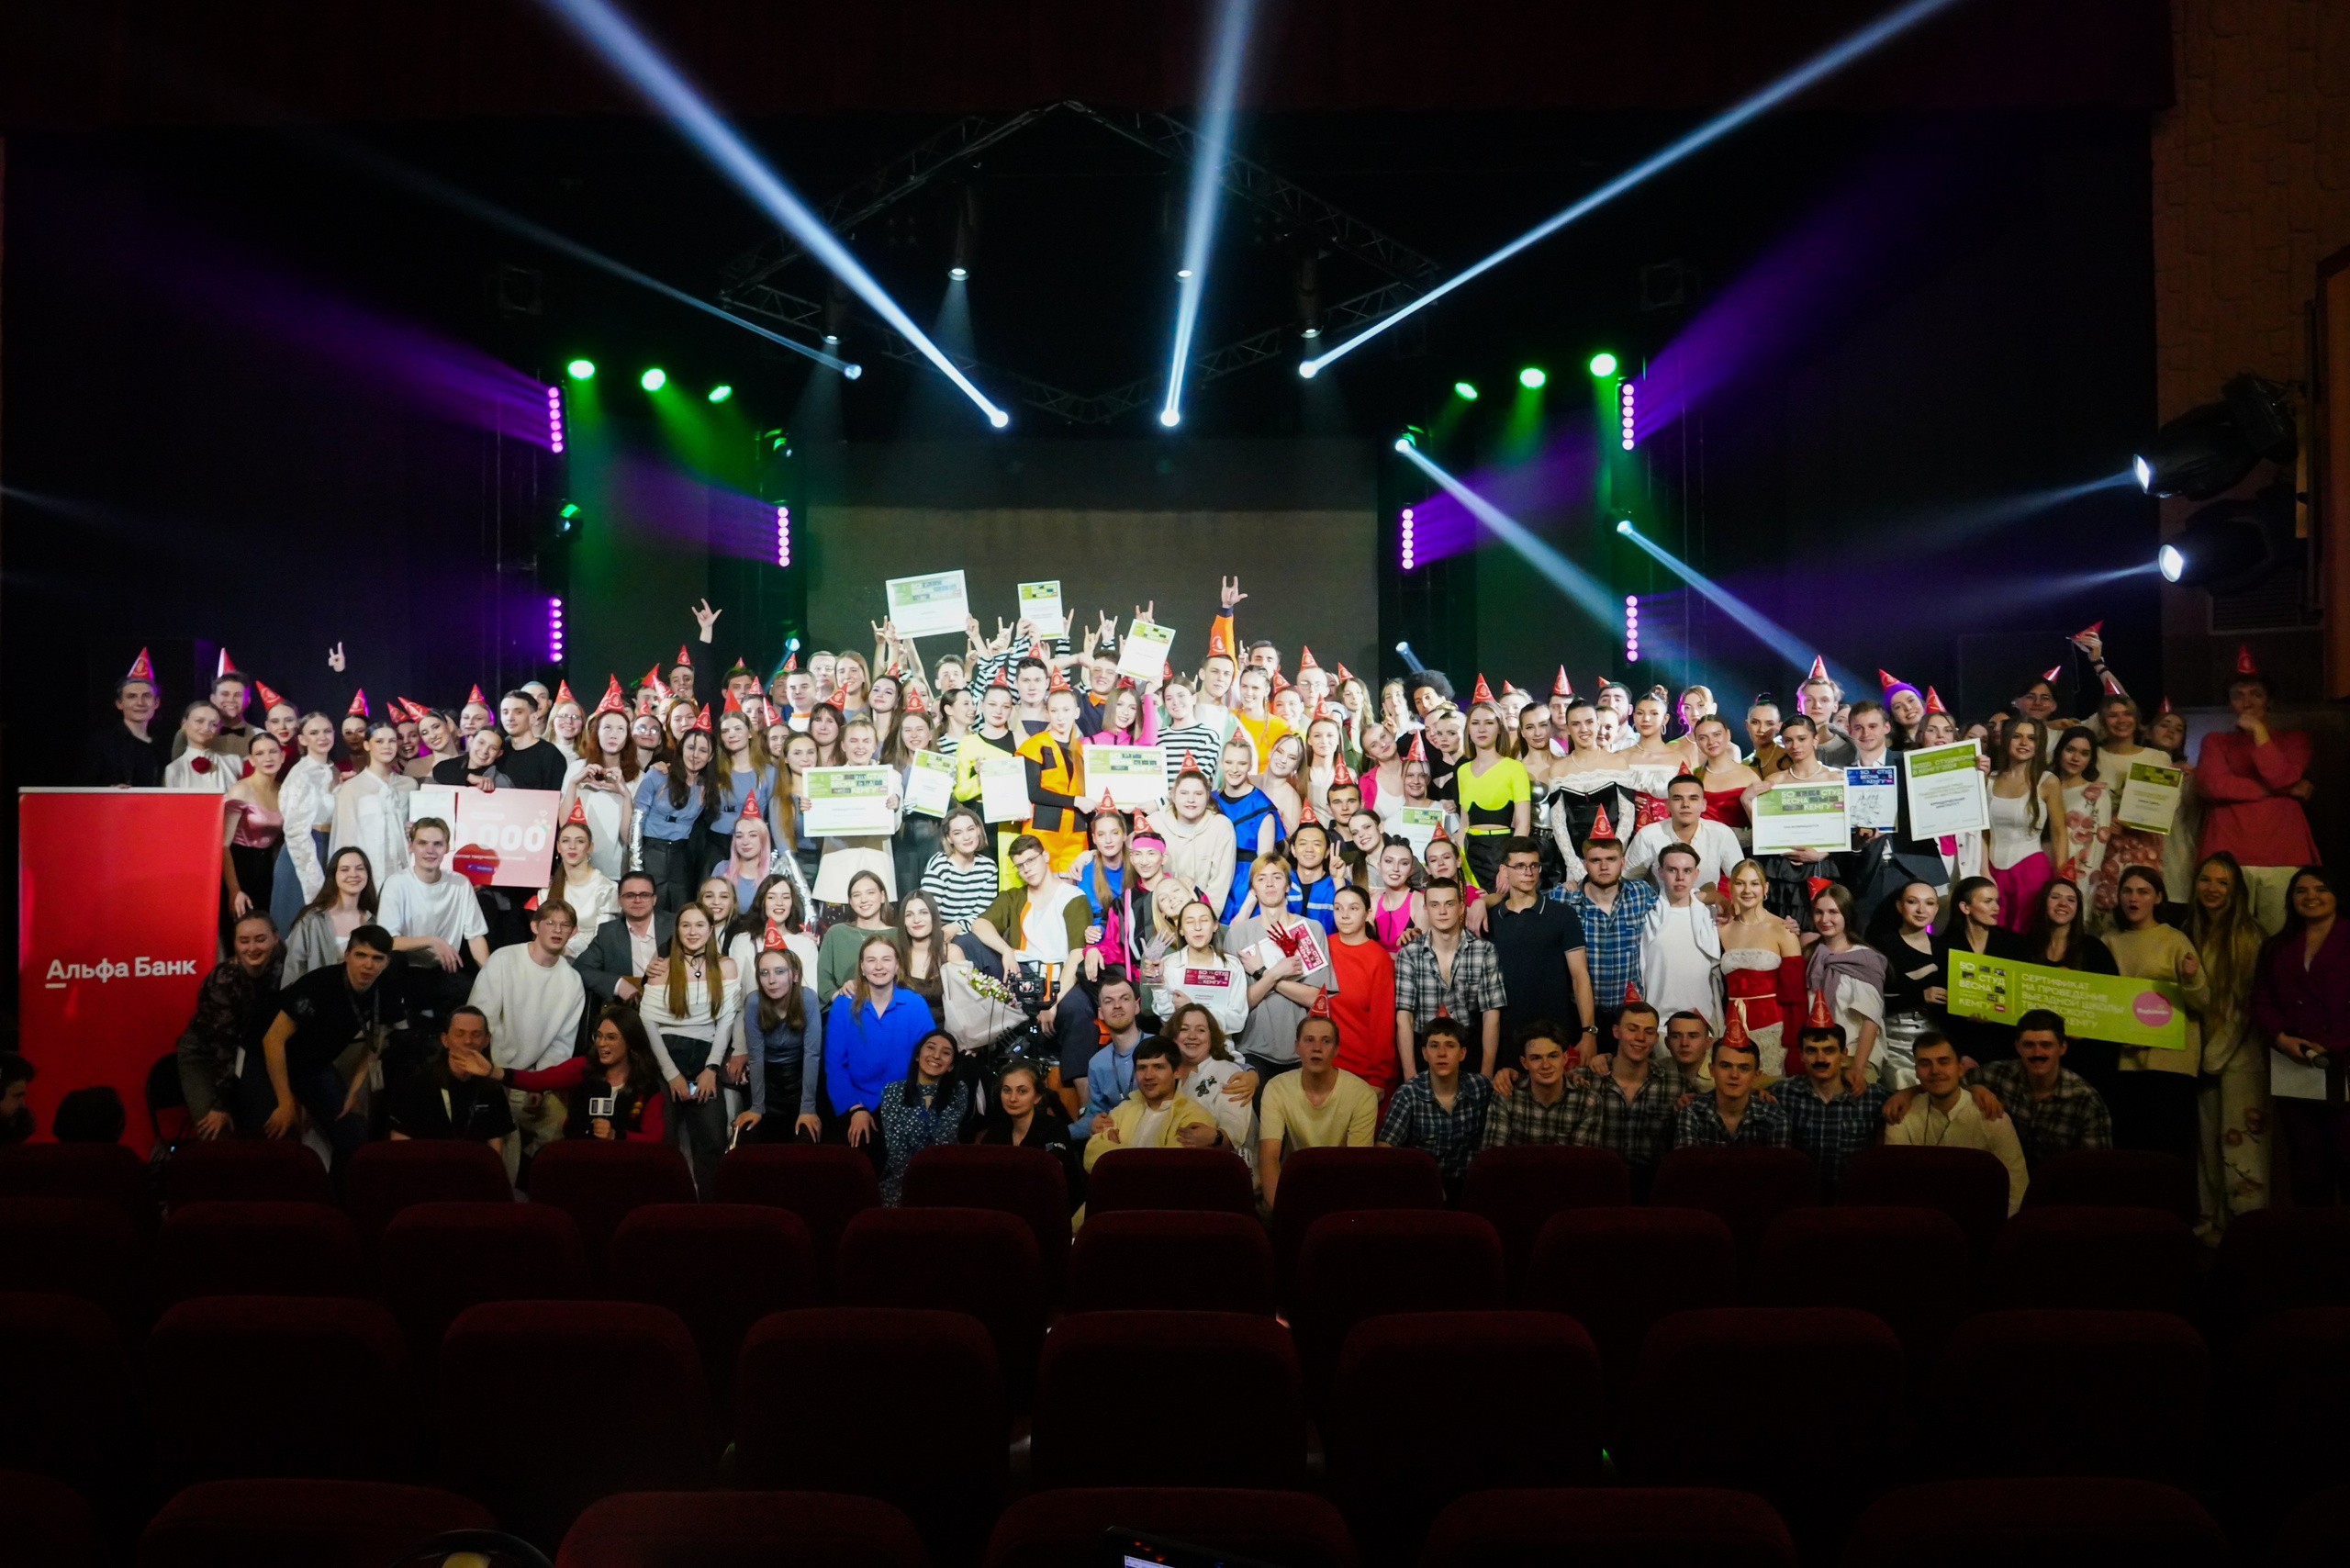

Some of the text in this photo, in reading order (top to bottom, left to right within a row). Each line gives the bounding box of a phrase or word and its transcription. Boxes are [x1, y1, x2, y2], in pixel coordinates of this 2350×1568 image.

[1781, 797, 1809, 805] ВЕСНА
[1804, 802, 1831, 811] КЕМГУ
[46, 957, 196, 985] Альфа Банк
[1959, 980, 1992, 992] ВЕСНА
[1978, 974, 2006, 987] СТУД
[2021, 973, 2090, 991] СЕРТИФИКАТ
[2021, 982, 2109, 1002] НА ПРОВЕДЕНИЕ
[1959, 998, 1992, 1010] КЕМГУ
[1998, 995, 2006, 1003] В
[2021, 991, 2079, 1007] ВЫЕЗДНОЙ
[2082, 1002, 2124, 1014] ШКОЛЫ
